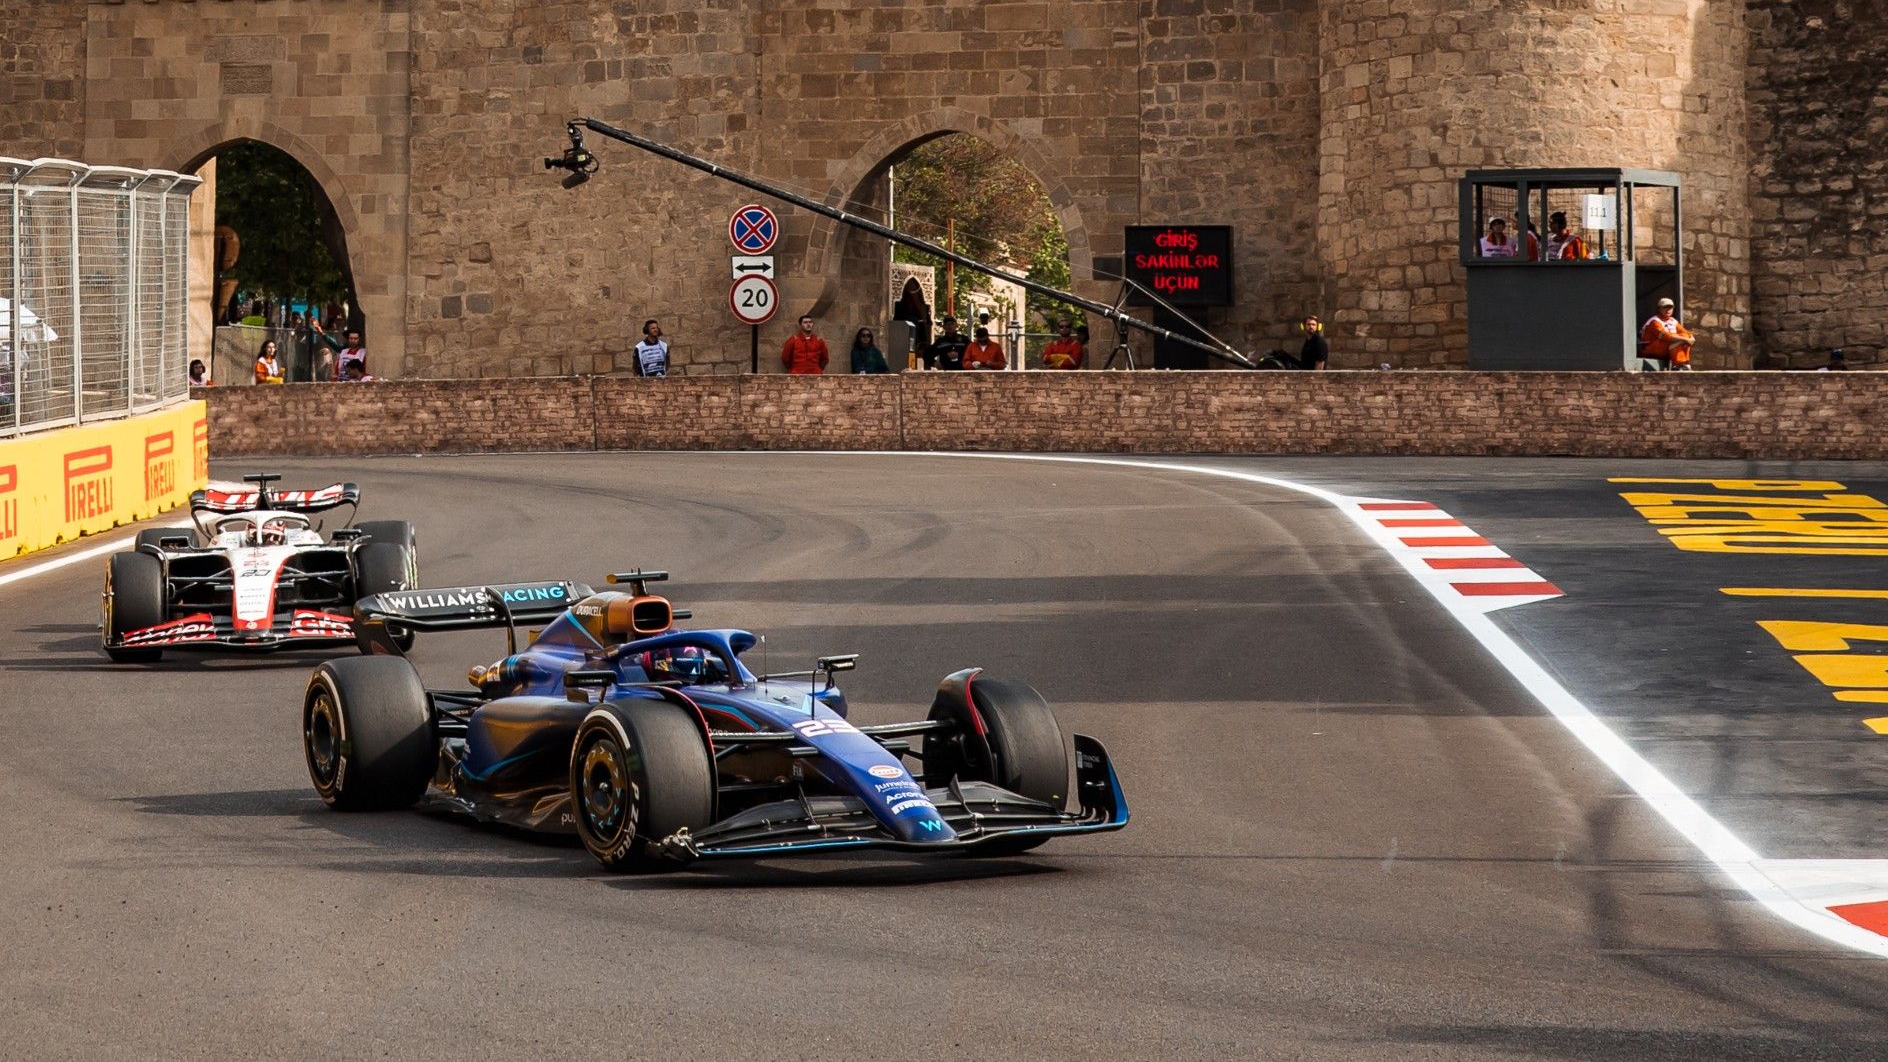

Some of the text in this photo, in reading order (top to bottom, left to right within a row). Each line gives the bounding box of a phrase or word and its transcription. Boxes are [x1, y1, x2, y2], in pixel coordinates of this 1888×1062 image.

[1153, 272, 1200, 294] ÜÇÜN
[741, 288, 769, 308] 20
[145, 430, 175, 501] PIRELLI
[64, 445, 113, 523] PIRELLI
[389, 586, 564, 609] WILLIAMS ACING
[294, 612, 356, 636] Gra
